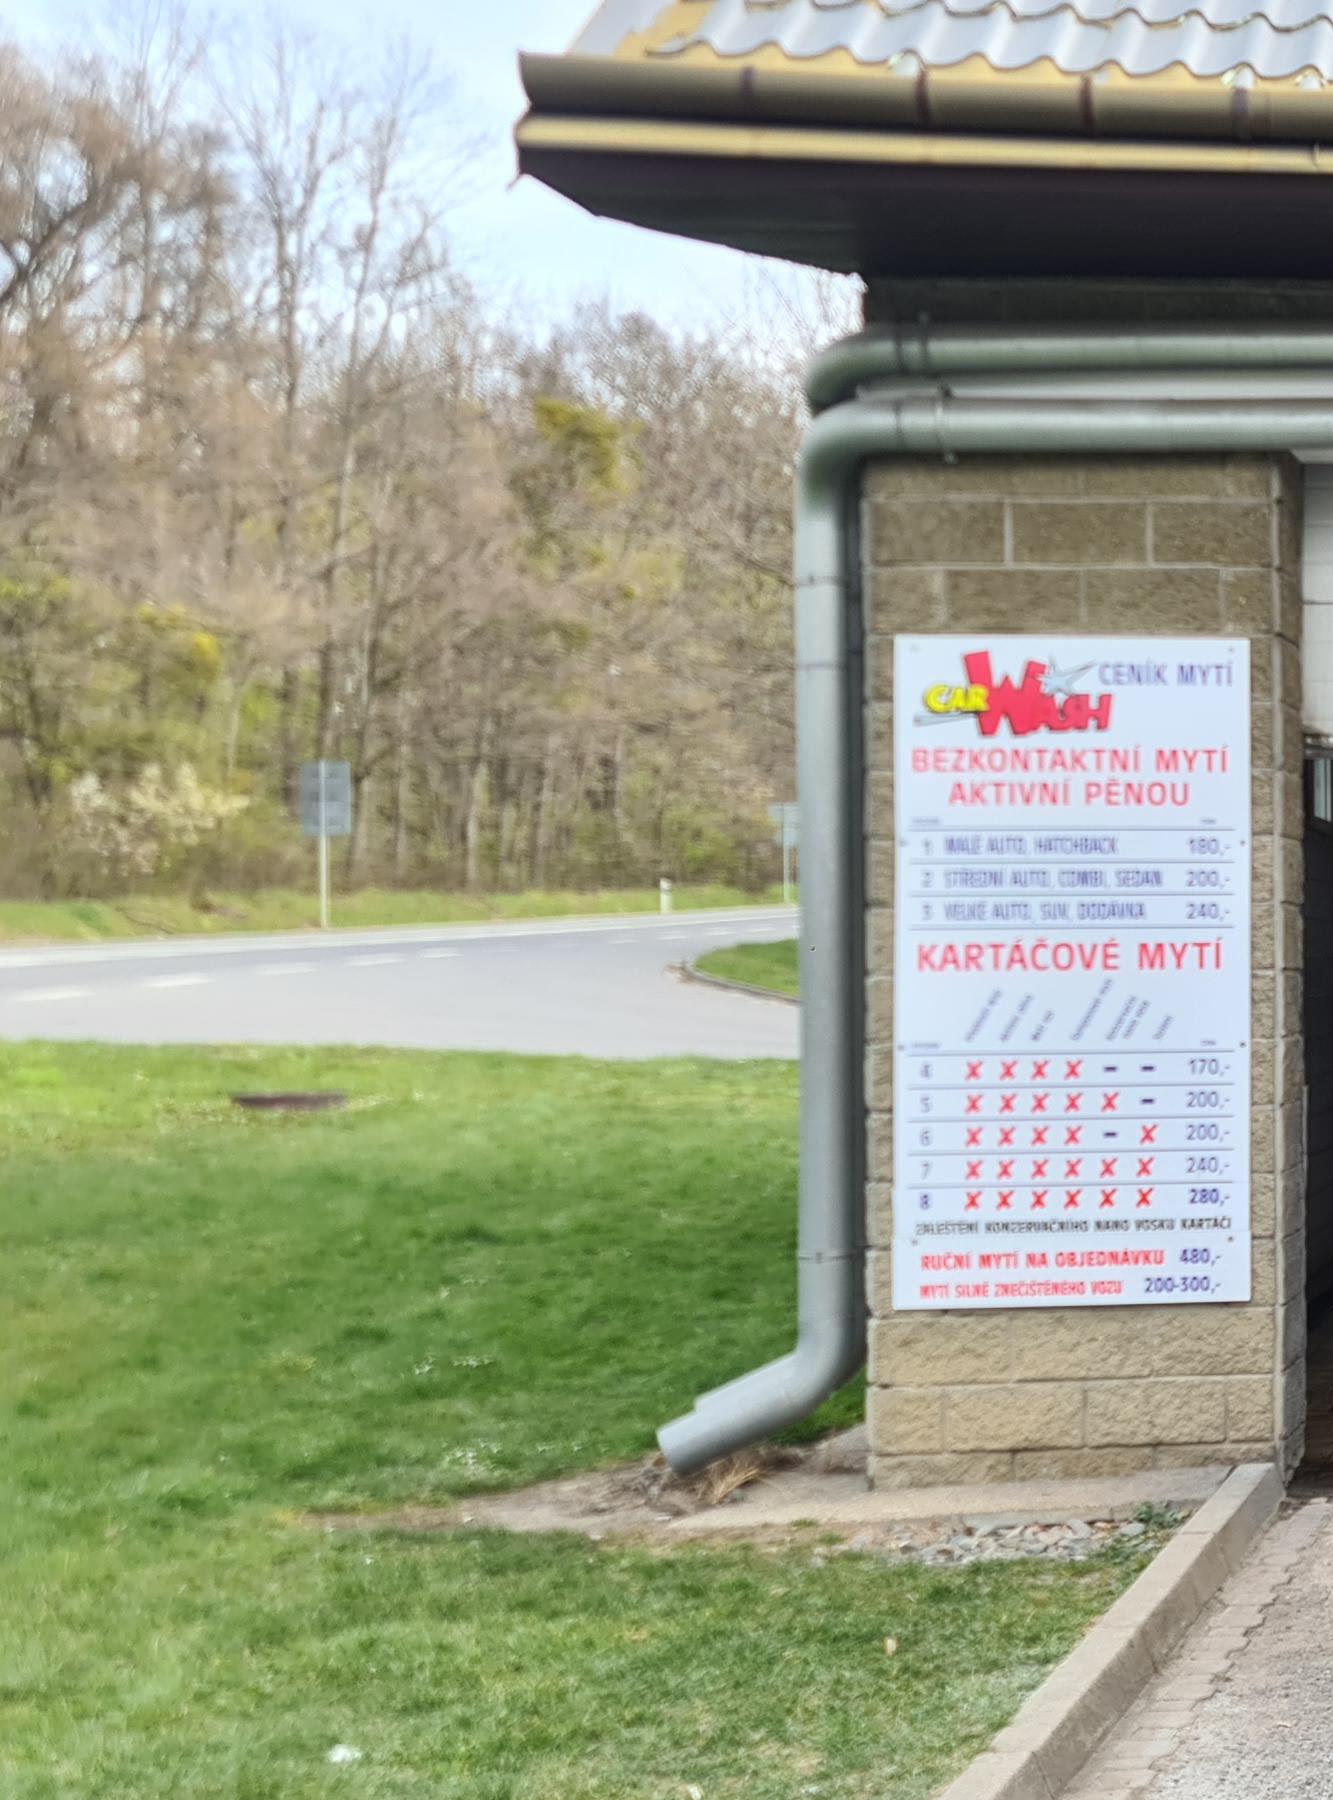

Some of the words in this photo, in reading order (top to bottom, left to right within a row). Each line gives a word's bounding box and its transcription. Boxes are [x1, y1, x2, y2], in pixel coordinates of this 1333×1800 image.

[1099, 660, 1167, 686] CENÍK
[1177, 660, 1234, 686] MYTÍ
[924, 684, 988, 713] CAR
[912, 744, 1141, 772] BEZKONTAKTNÍ
[1154, 744, 1229, 773] MYTÍ
[949, 778, 1070, 806] AKTIVNÍ
[1085, 777, 1190, 806] PĚNOU
[1033, 837, 1119, 856] HATCHBACK
[921, 871, 933, 888] 2
[1116, 869, 1164, 888] SEDAN
[1186, 870, 1231, 889] 200,-
[1186, 902, 1231, 922] 240,-
[917, 938, 1121, 972] KARTÁČOVÉ
[1138, 937, 1225, 971] MYTÍ
[1188, 1058, 1231, 1077] 170,-
[1186, 1091, 1231, 1110] 200,-
[1186, 1124, 1231, 1143] 200,-
[920, 1161, 932, 1178] 7
[1186, 1156, 1230, 1175] 240,-
[1188, 1188, 1231, 1206] 280,-
[920, 1249, 972, 1271] RUČNÍ
[978, 1249, 1018, 1270] MYTÍ
[1025, 1250, 1049, 1268] NA
[1055, 1246, 1166, 1268] OBJEDNÁVKU
[1180, 1248, 1222, 1267] 480,-
[1090, 1278, 1123, 1295] VOZU
